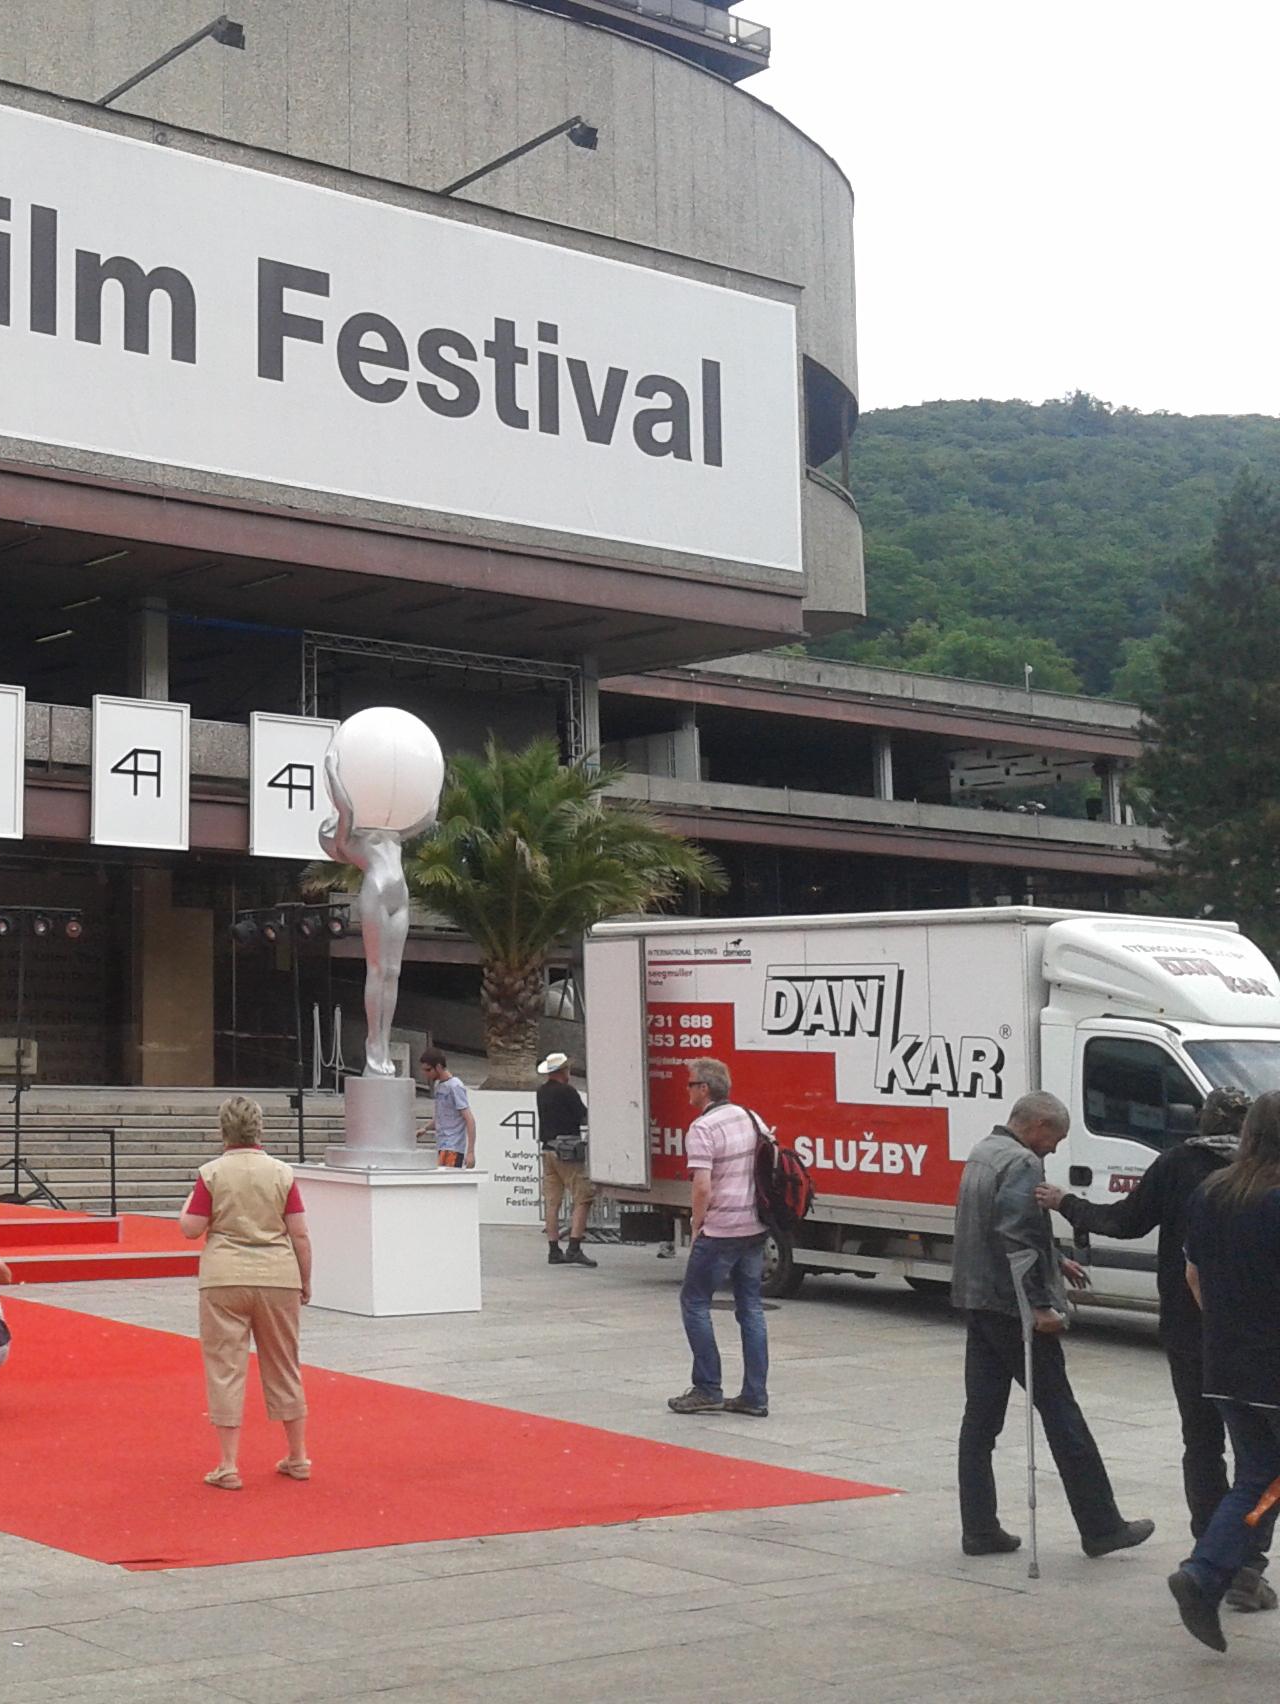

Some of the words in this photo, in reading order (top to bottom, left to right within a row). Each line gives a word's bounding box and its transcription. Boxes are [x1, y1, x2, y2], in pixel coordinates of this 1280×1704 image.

[258, 258, 723, 468] Festival
[762, 963, 904, 1037] DAN
[679, 1014, 714, 1029] 688
[679, 1034, 714, 1049] 206
[874, 1033, 1005, 1100] KAR
[505, 1150, 540, 1162] Karlovy
[794, 1131, 929, 1176] SLUŽBY
[512, 1163, 534, 1173] Vary
[494, 1173, 540, 1183] Internatio
[513, 1185, 534, 1195] Film
[506, 1197, 540, 1208] Festiva
